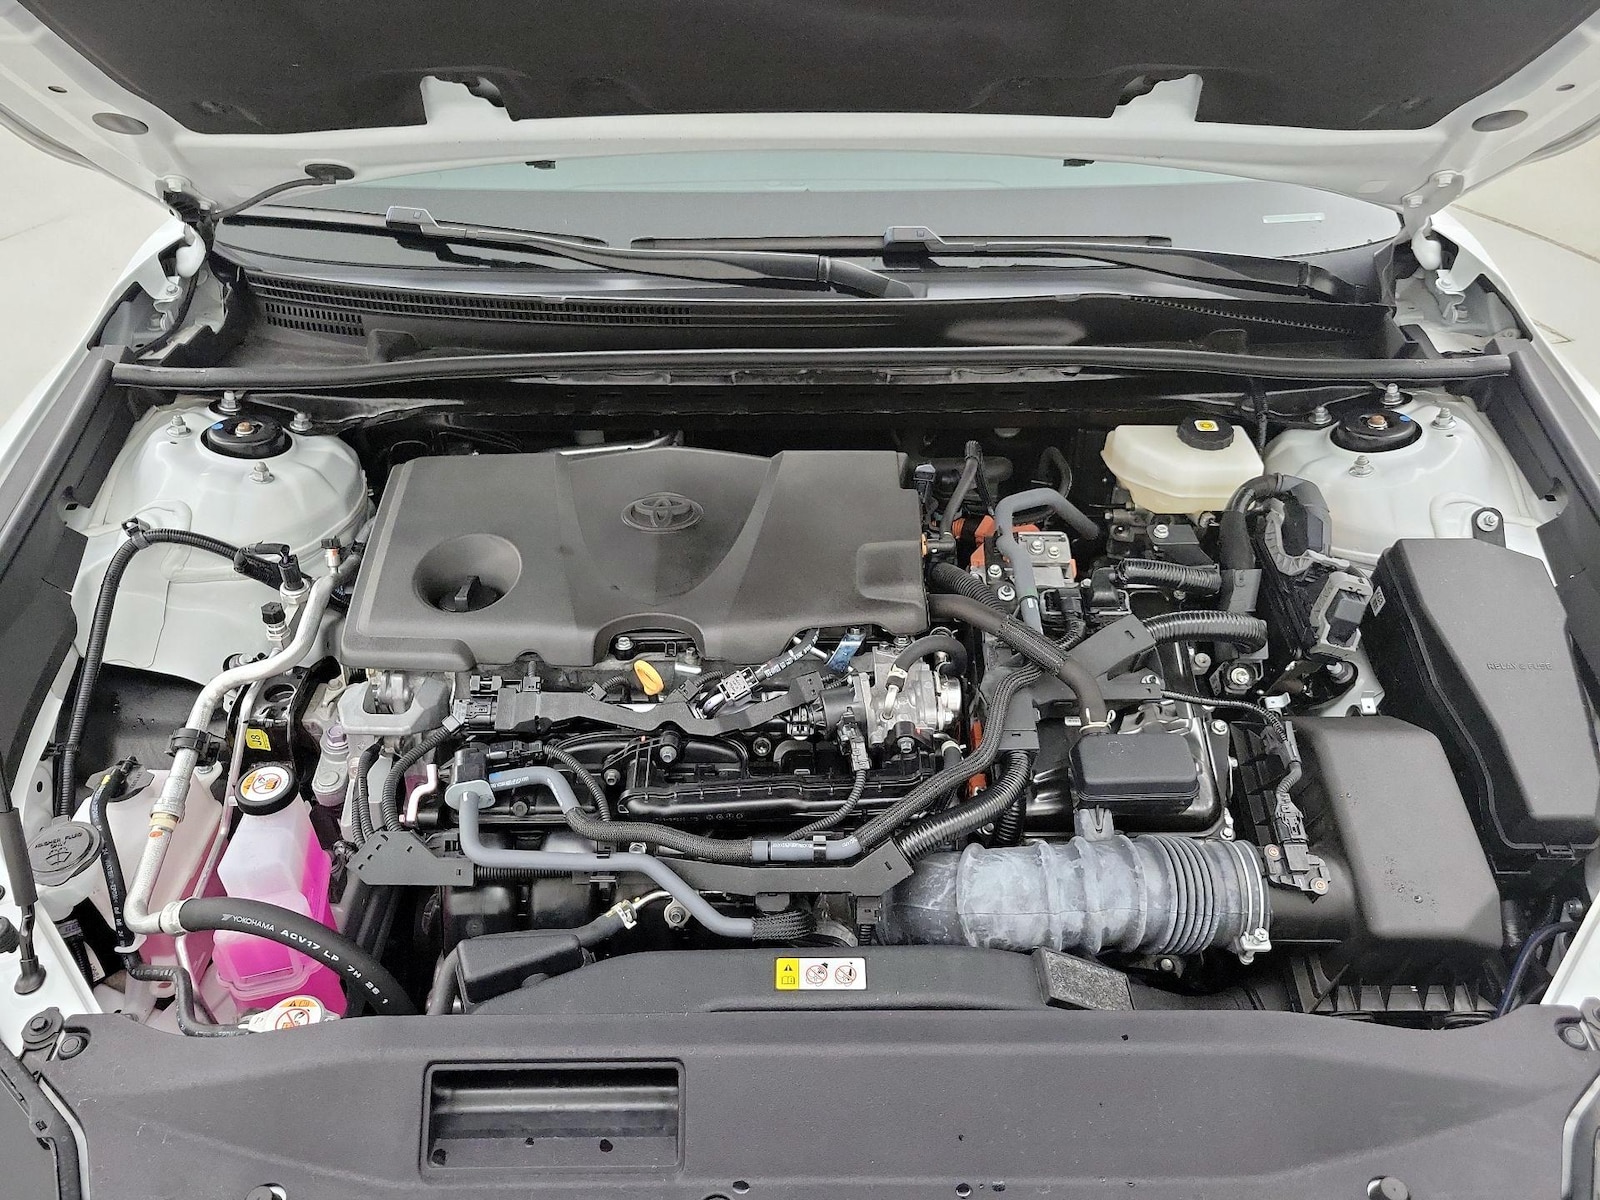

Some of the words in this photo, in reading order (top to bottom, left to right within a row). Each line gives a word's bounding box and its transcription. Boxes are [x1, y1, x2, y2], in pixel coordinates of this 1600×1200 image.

[1487, 663, 1518, 671] RELAY
[1528, 662, 1552, 671] FUSE
[232, 914, 275, 932] YOKOHAMA
[280, 929, 321, 950] ACV17
[323, 949, 340, 962] LP
